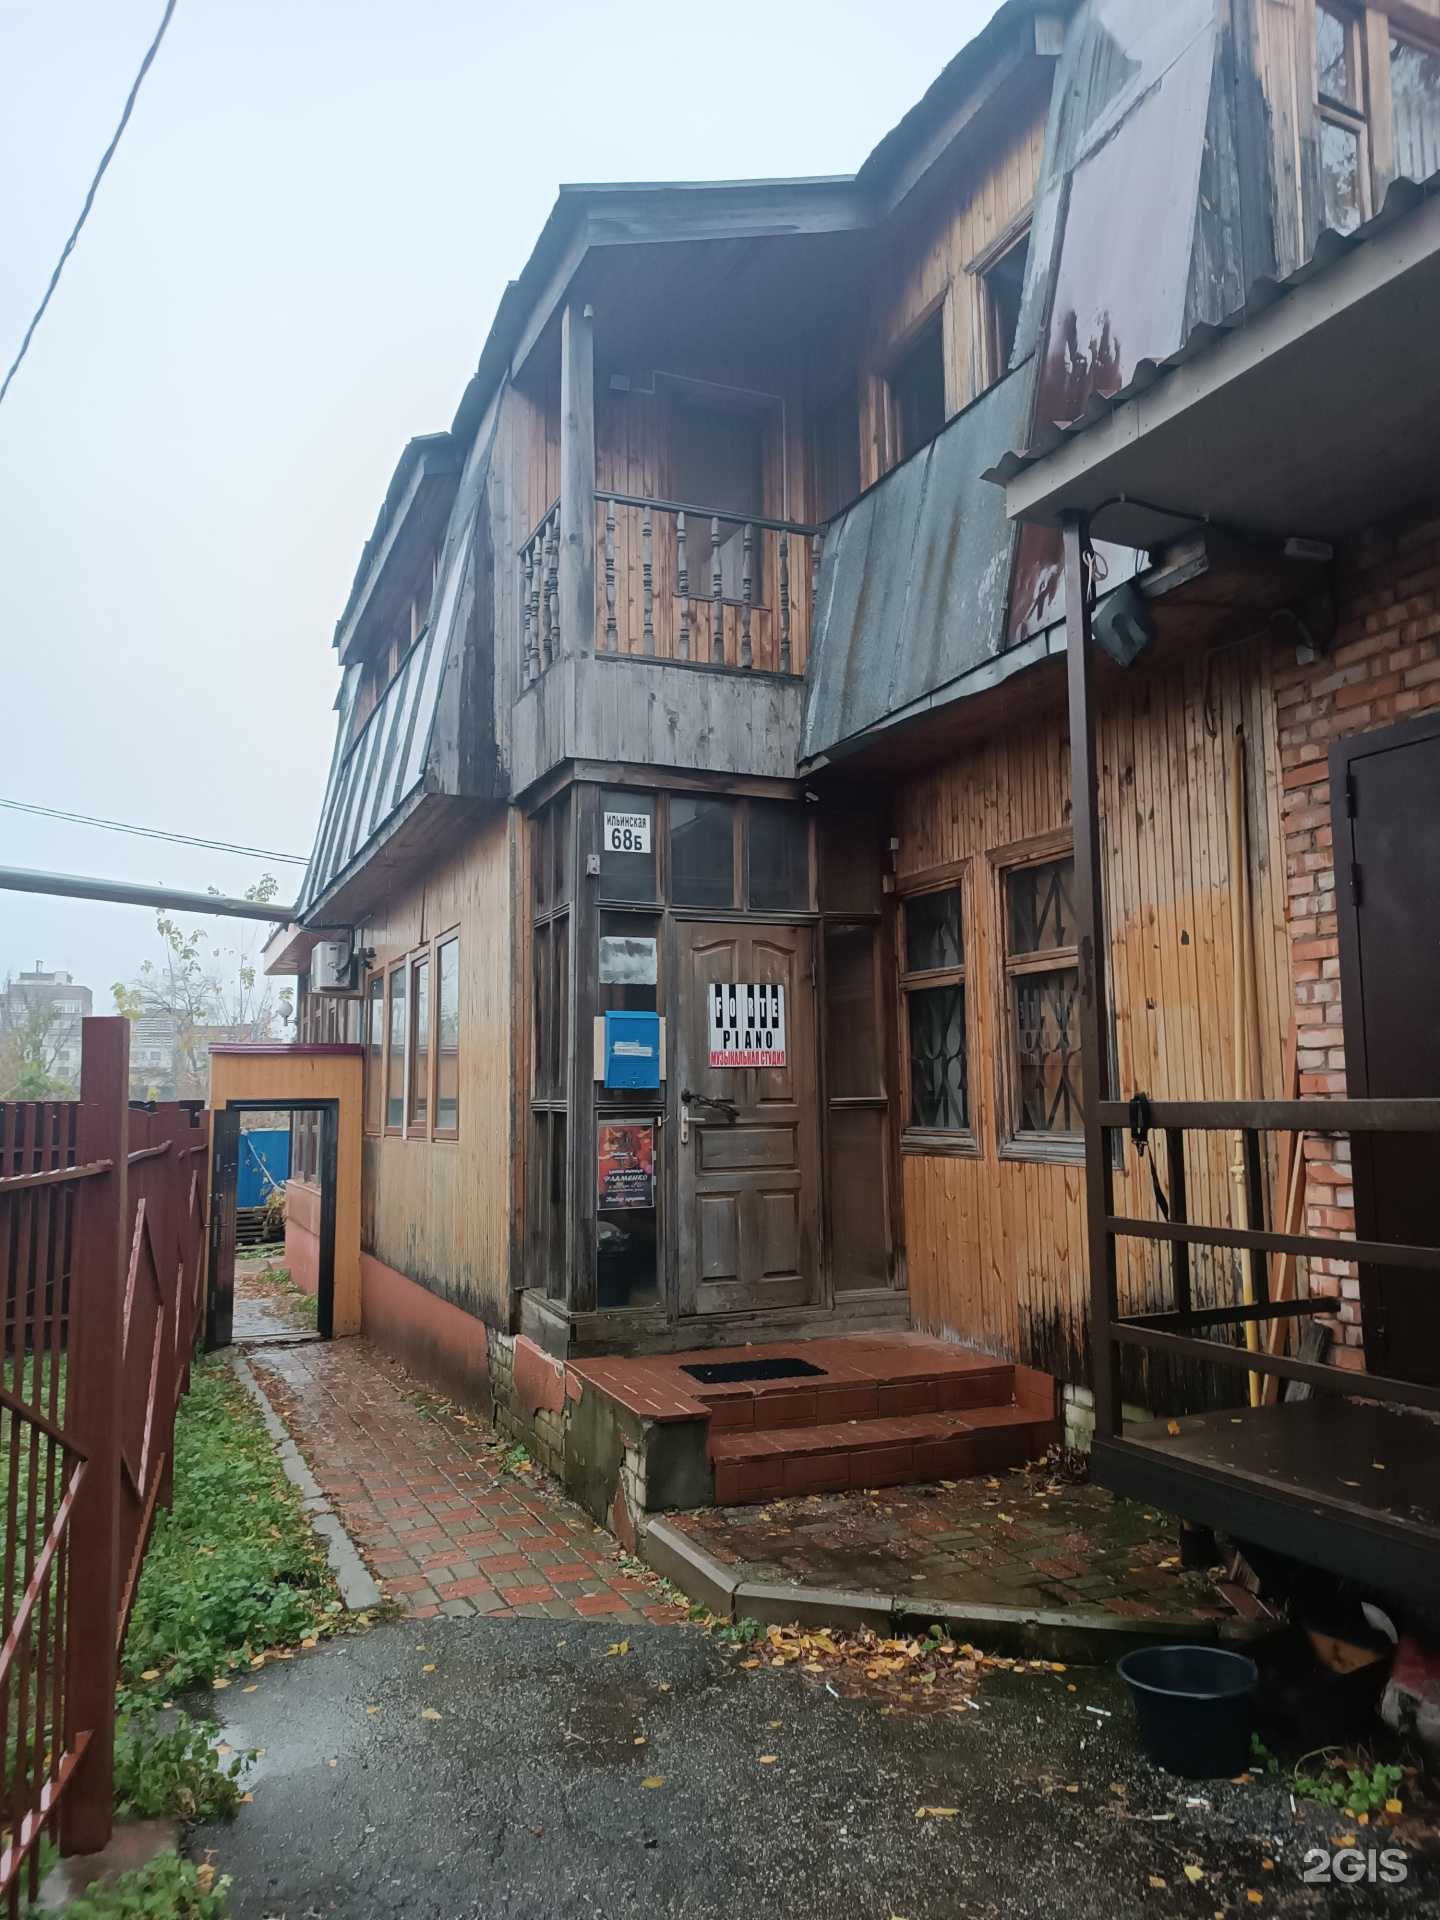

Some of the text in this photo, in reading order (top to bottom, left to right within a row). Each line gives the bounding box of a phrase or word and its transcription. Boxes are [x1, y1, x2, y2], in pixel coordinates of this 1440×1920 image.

[606, 815, 647, 828] ИЛЬИНСКАЯ
[715, 996, 779, 1018] FORTE
[723, 1030, 773, 1049] PIANO
[711, 1050, 785, 1066] МУЗЫКАЛЬНАЯ СТУДИЯ
